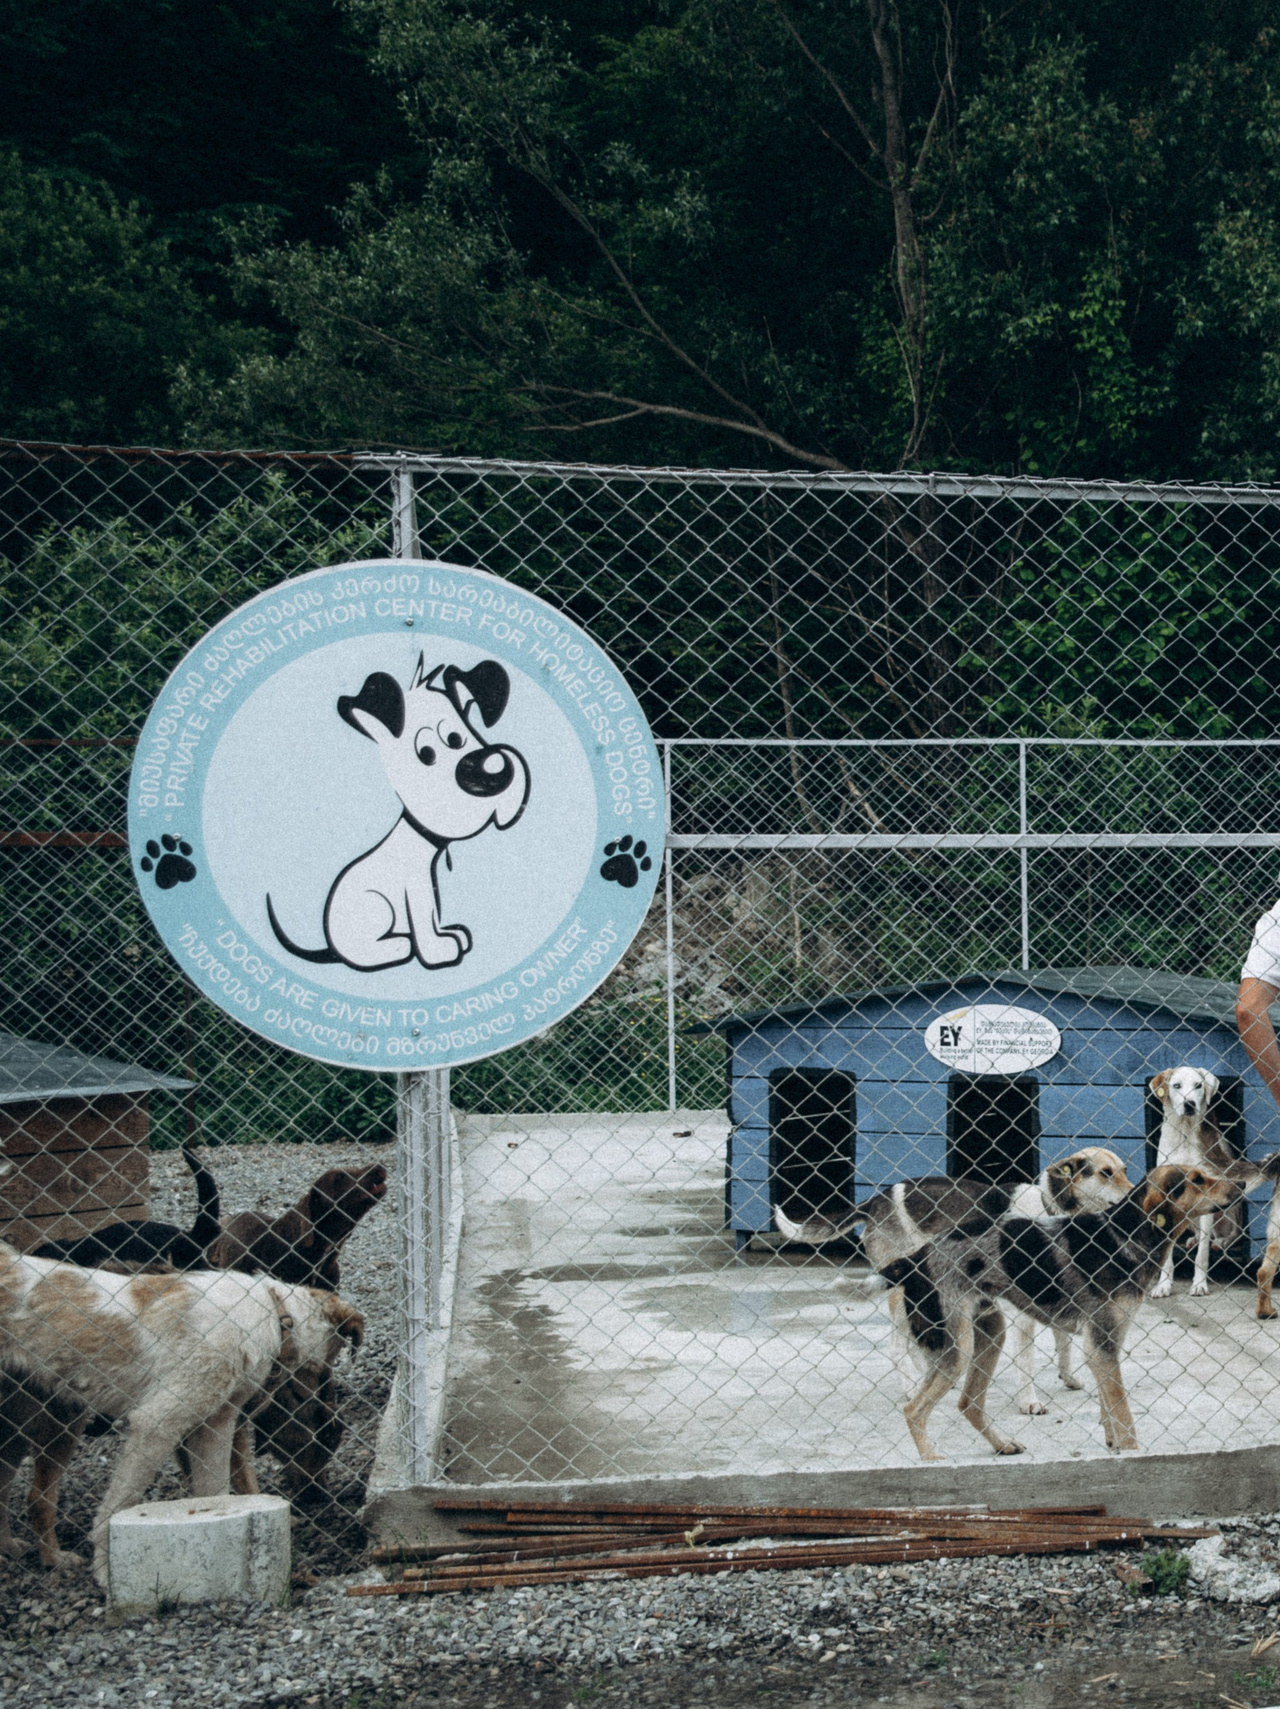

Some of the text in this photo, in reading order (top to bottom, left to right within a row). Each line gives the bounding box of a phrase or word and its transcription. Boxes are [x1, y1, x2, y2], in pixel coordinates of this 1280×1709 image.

[203, 589, 324, 671] ძაღლების
[331, 574, 420, 601] კერძო
[164, 712, 210, 808] PRIVATE
[199, 601, 367, 712] REHABILITATION
[374, 598, 473, 626] CENTER
[478, 613, 526, 650] FOR
[528, 640, 616, 746] HOMELESS
[216, 929, 273, 984] DOGS
[269, 977, 319, 1010] ARE
[321, 999, 391, 1027] GIVEN
[397, 1008, 429, 1027] TO
[435, 981, 519, 1024] CARING
[264, 1007, 379, 1054] ძაღლები
[386, 1012, 516, 1056] მზრუნველ
[940, 1025, 963, 1047] EY
